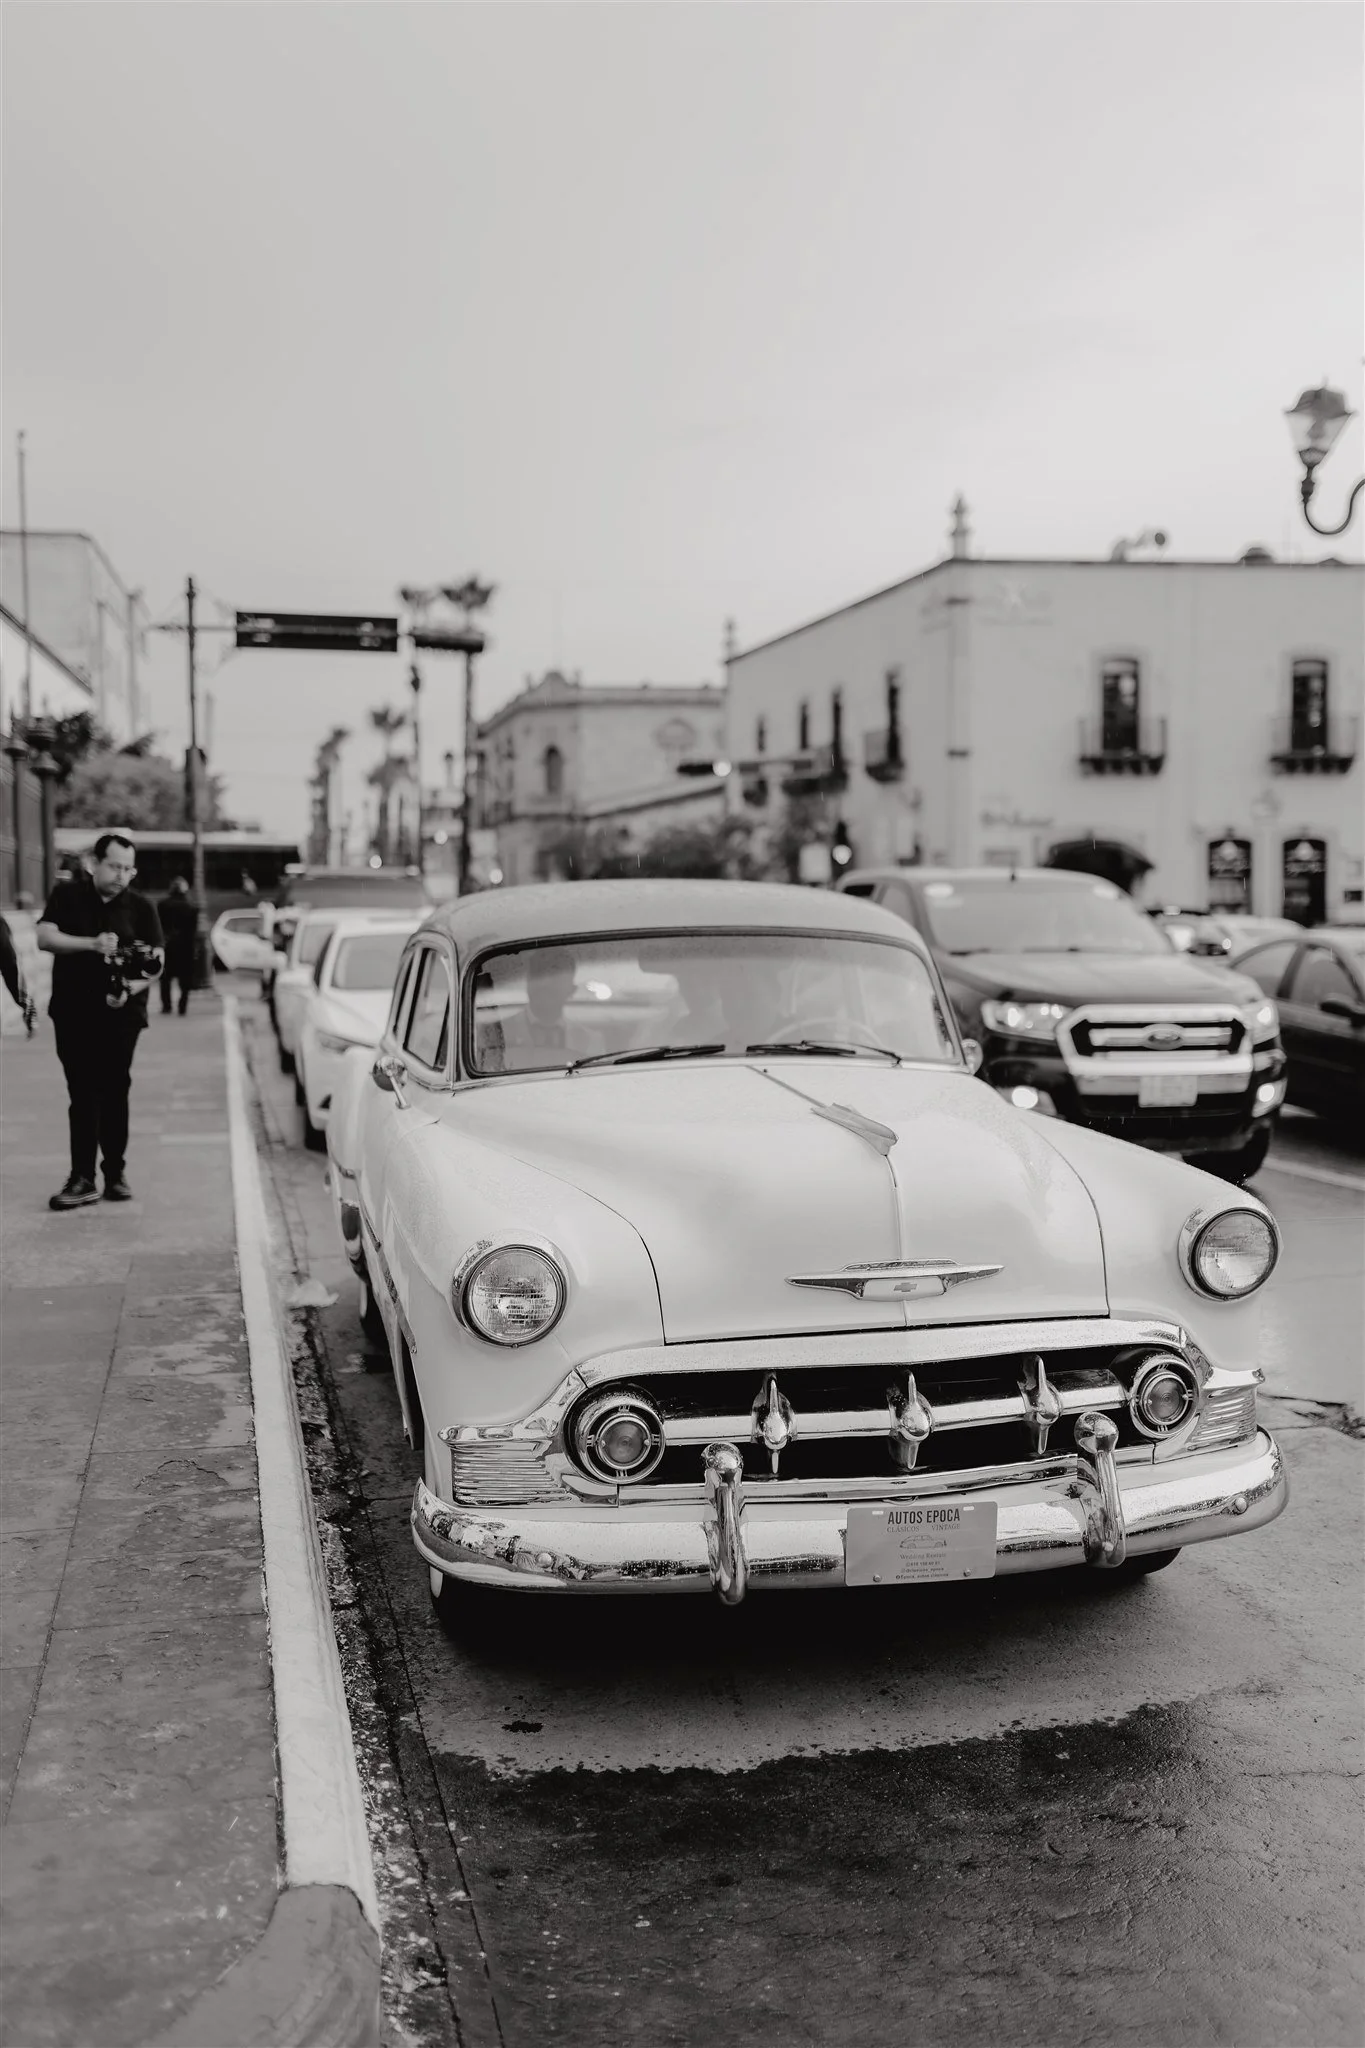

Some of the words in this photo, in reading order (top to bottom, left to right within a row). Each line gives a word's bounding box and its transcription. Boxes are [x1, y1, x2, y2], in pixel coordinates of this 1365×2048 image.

[887, 1511, 923, 1525] AUTOS
[926, 1508, 960, 1524] EPOCA
[931, 1523, 960, 1531] VINTAGE
